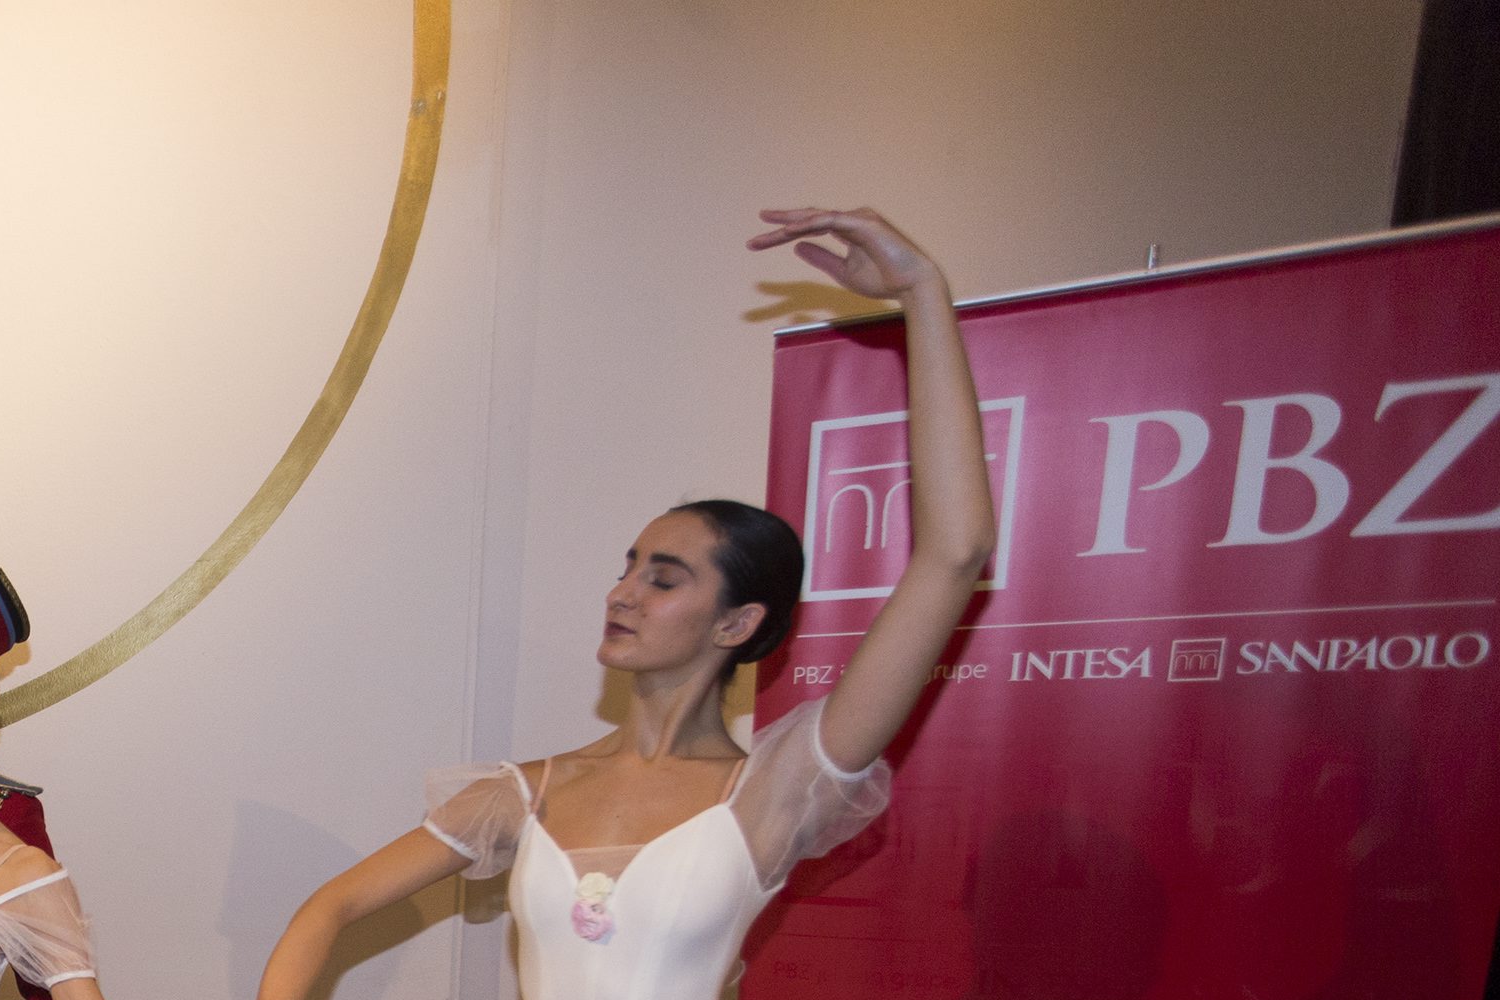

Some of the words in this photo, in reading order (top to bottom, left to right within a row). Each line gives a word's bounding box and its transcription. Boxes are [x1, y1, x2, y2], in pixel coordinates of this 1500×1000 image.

[1076, 372, 1500, 558] PBZ
[792, 664, 833, 685] PBZ
[1007, 646, 1152, 682] INTESA
[1236, 631, 1490, 676] SANPAOLO
